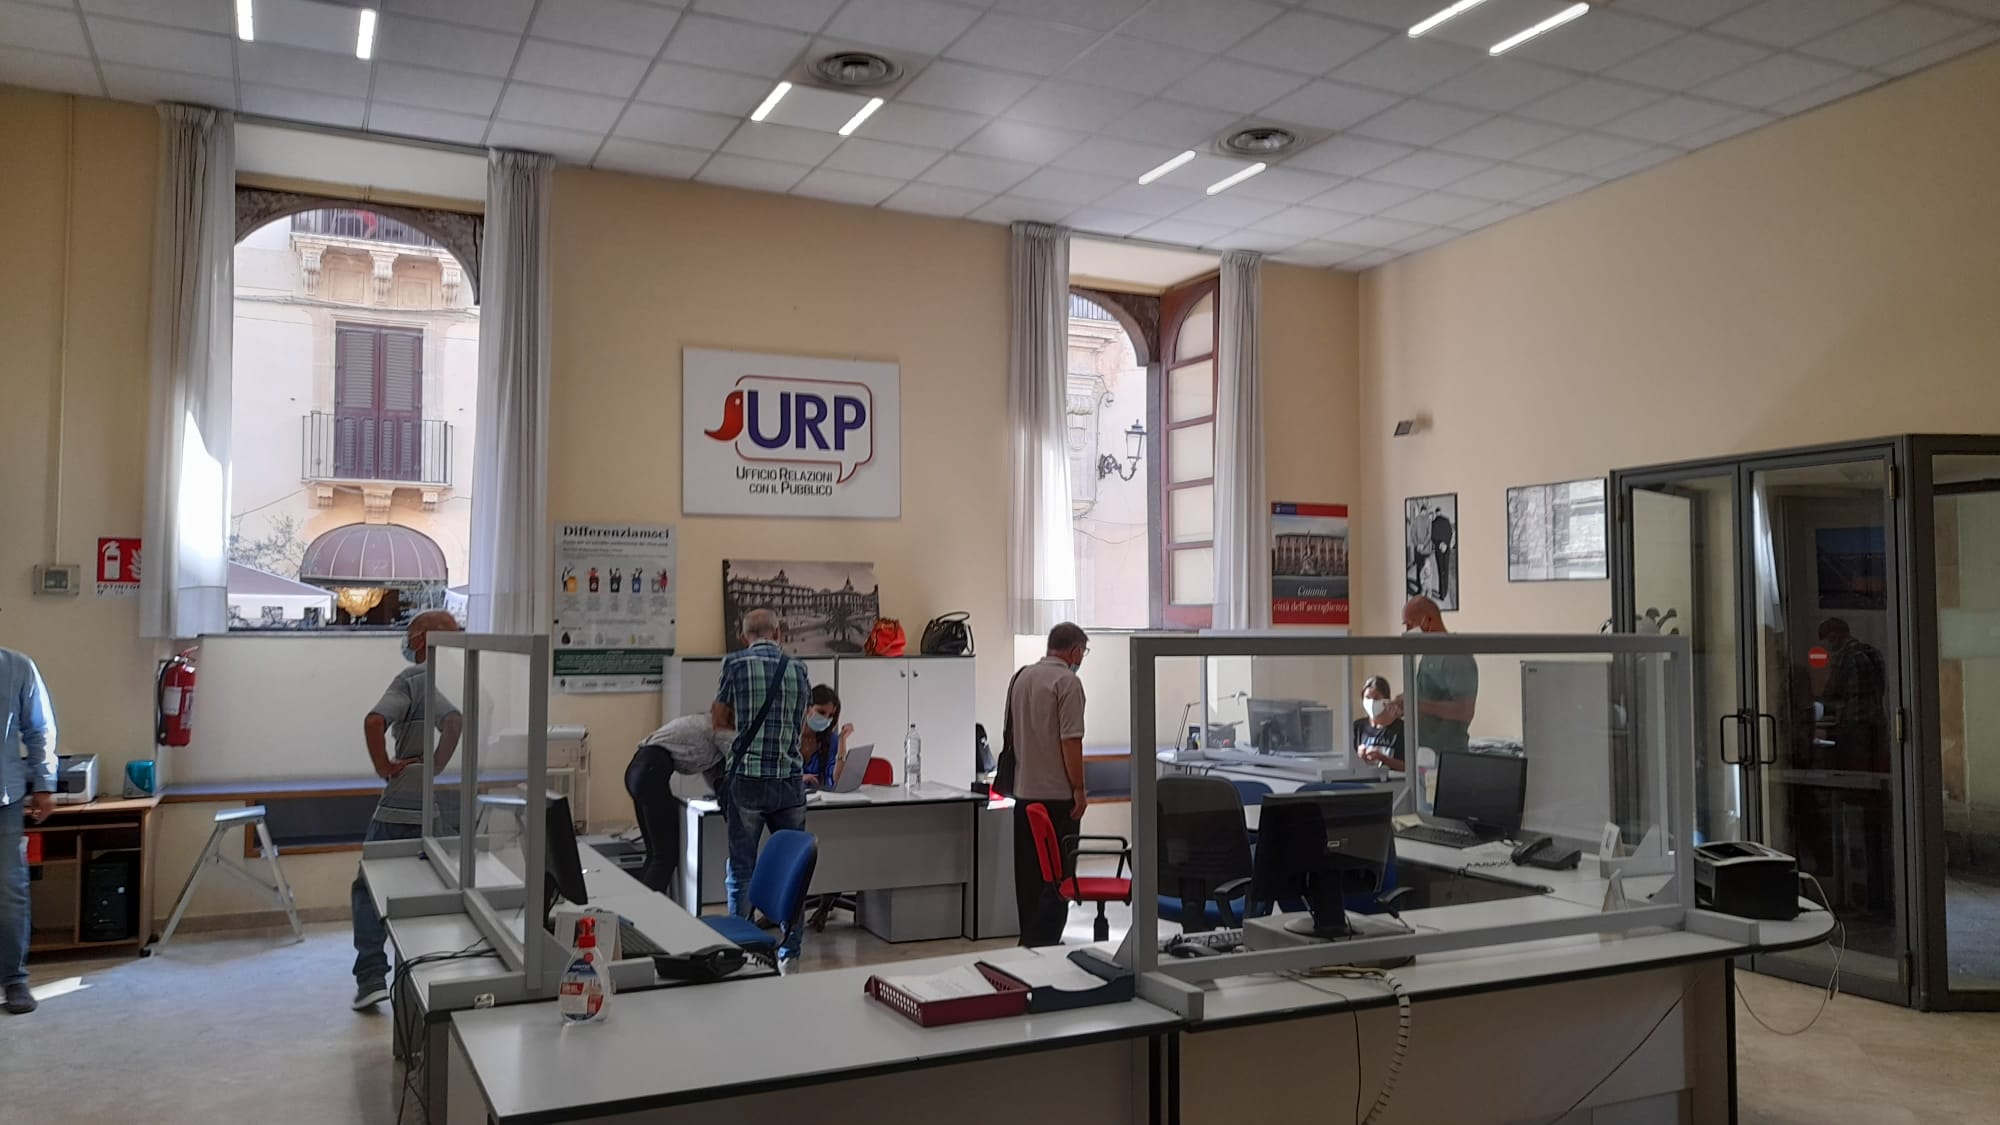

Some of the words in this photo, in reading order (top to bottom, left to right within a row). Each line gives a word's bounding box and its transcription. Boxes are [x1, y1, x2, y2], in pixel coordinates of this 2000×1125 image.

[747, 390, 866, 450] URP
[736, 466, 777, 480] UFFICIO
[779, 467, 833, 482] RELAZIONI
[749, 483, 770, 494] CON
[771, 484, 779, 495] IL
[781, 481, 833, 496] PUBBLICO
[563, 525, 669, 539] Differenziamoci
[1297, 584, 1328, 597] Catania
